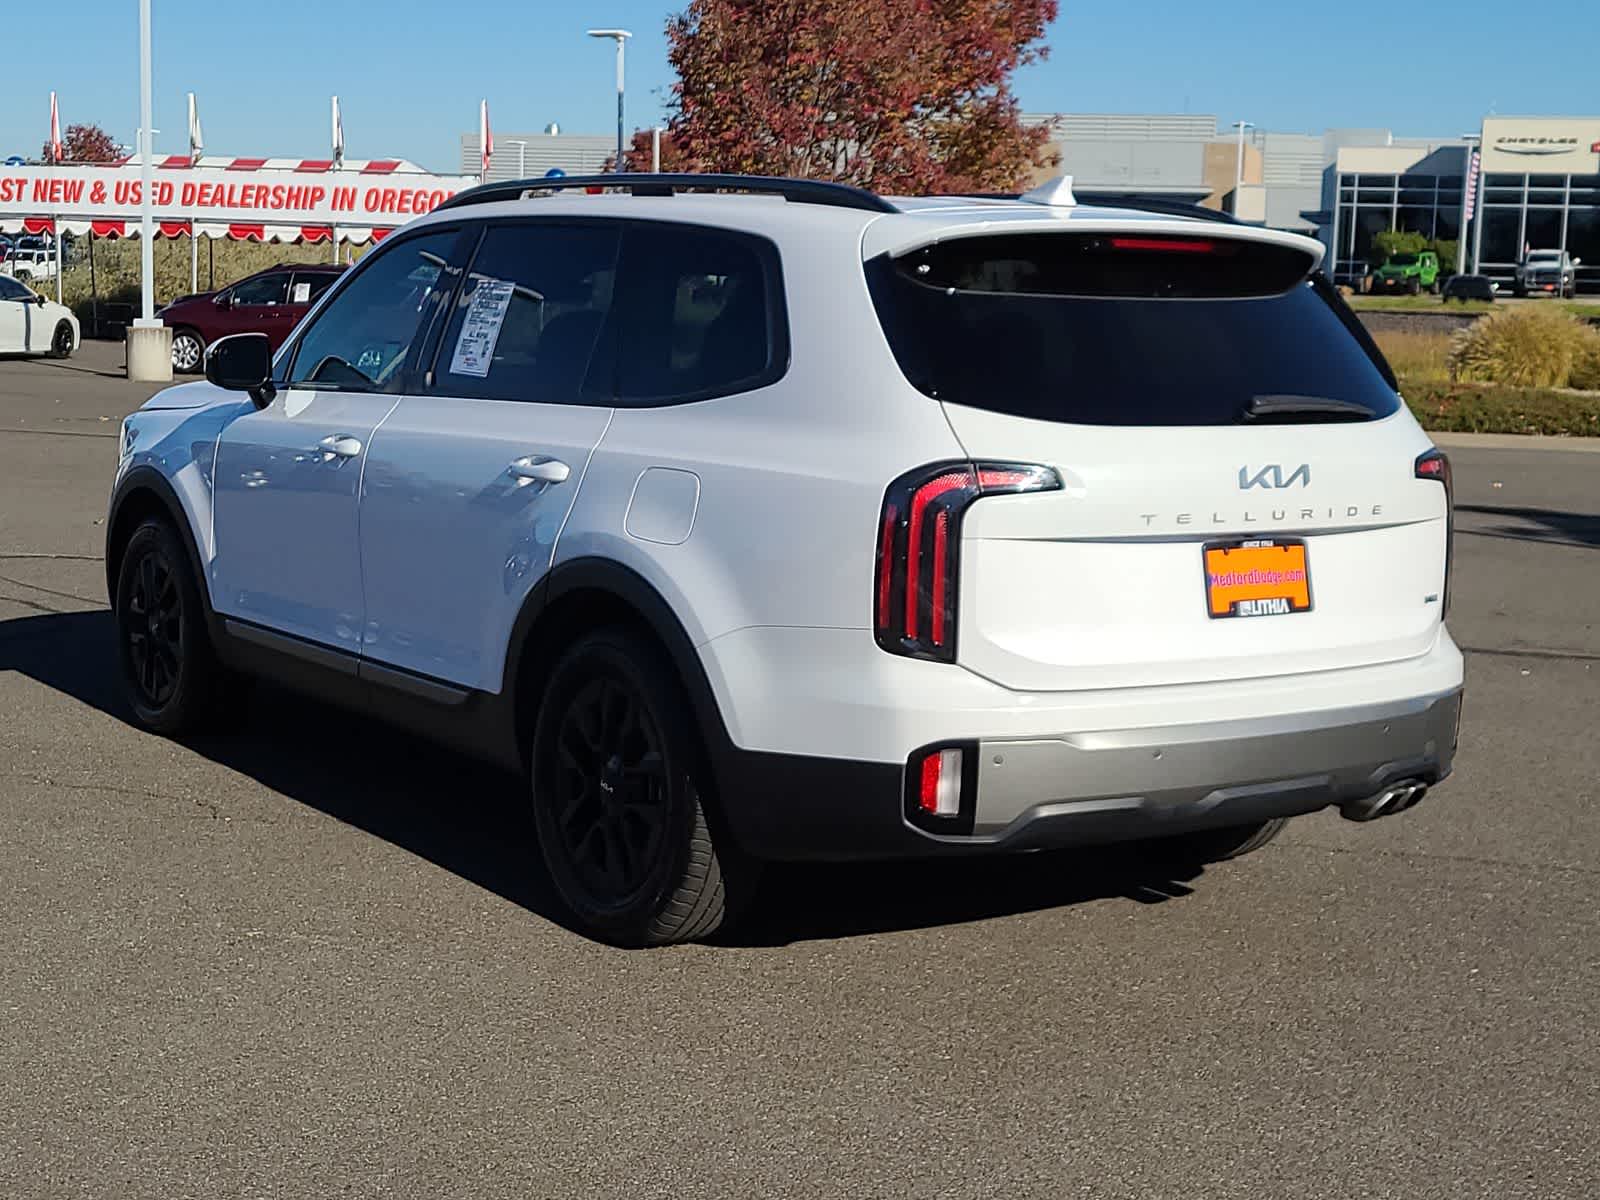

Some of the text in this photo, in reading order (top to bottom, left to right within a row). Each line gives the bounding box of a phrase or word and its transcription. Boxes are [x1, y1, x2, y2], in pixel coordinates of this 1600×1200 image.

[0, 178, 28, 202] ST
[33, 179, 85, 203] NEW
[89, 180, 108, 204] &
[181, 182, 325, 210] DEALERSHIP
[331, 186, 357, 211] IN
[364, 188, 455, 214] OREGO
[1141, 505, 1383, 525] TELLURIDE
